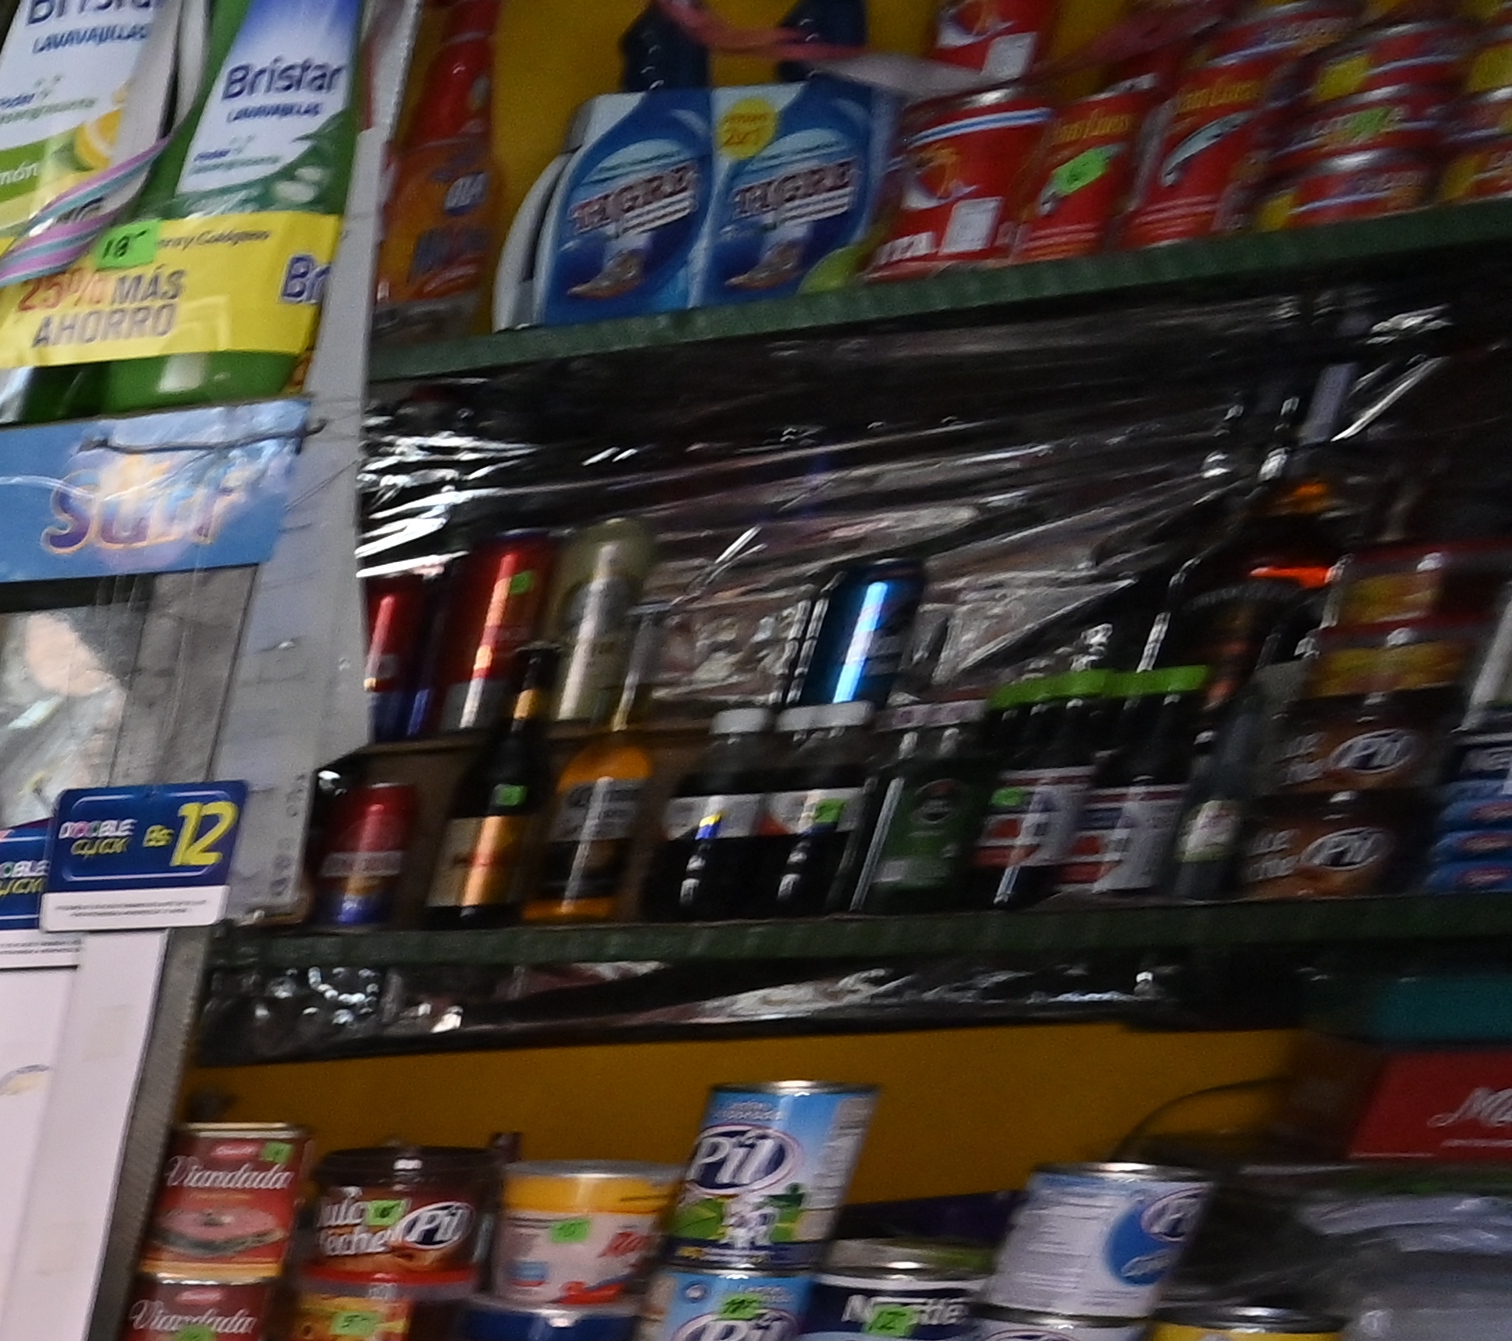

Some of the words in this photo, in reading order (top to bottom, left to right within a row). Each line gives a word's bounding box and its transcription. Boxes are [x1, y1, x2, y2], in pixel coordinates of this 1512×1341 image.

[223, 56, 345, 101] Bristar
[32, 303, 178, 348] AHORRO
[170, 801, 241, 867] 12
[166, 1155, 296, 1191] Viandada
[687, 1127, 788, 1186] Pil
[401, 1203, 463, 1246] Pil
[129, 1299, 258, 1335] Viandada
